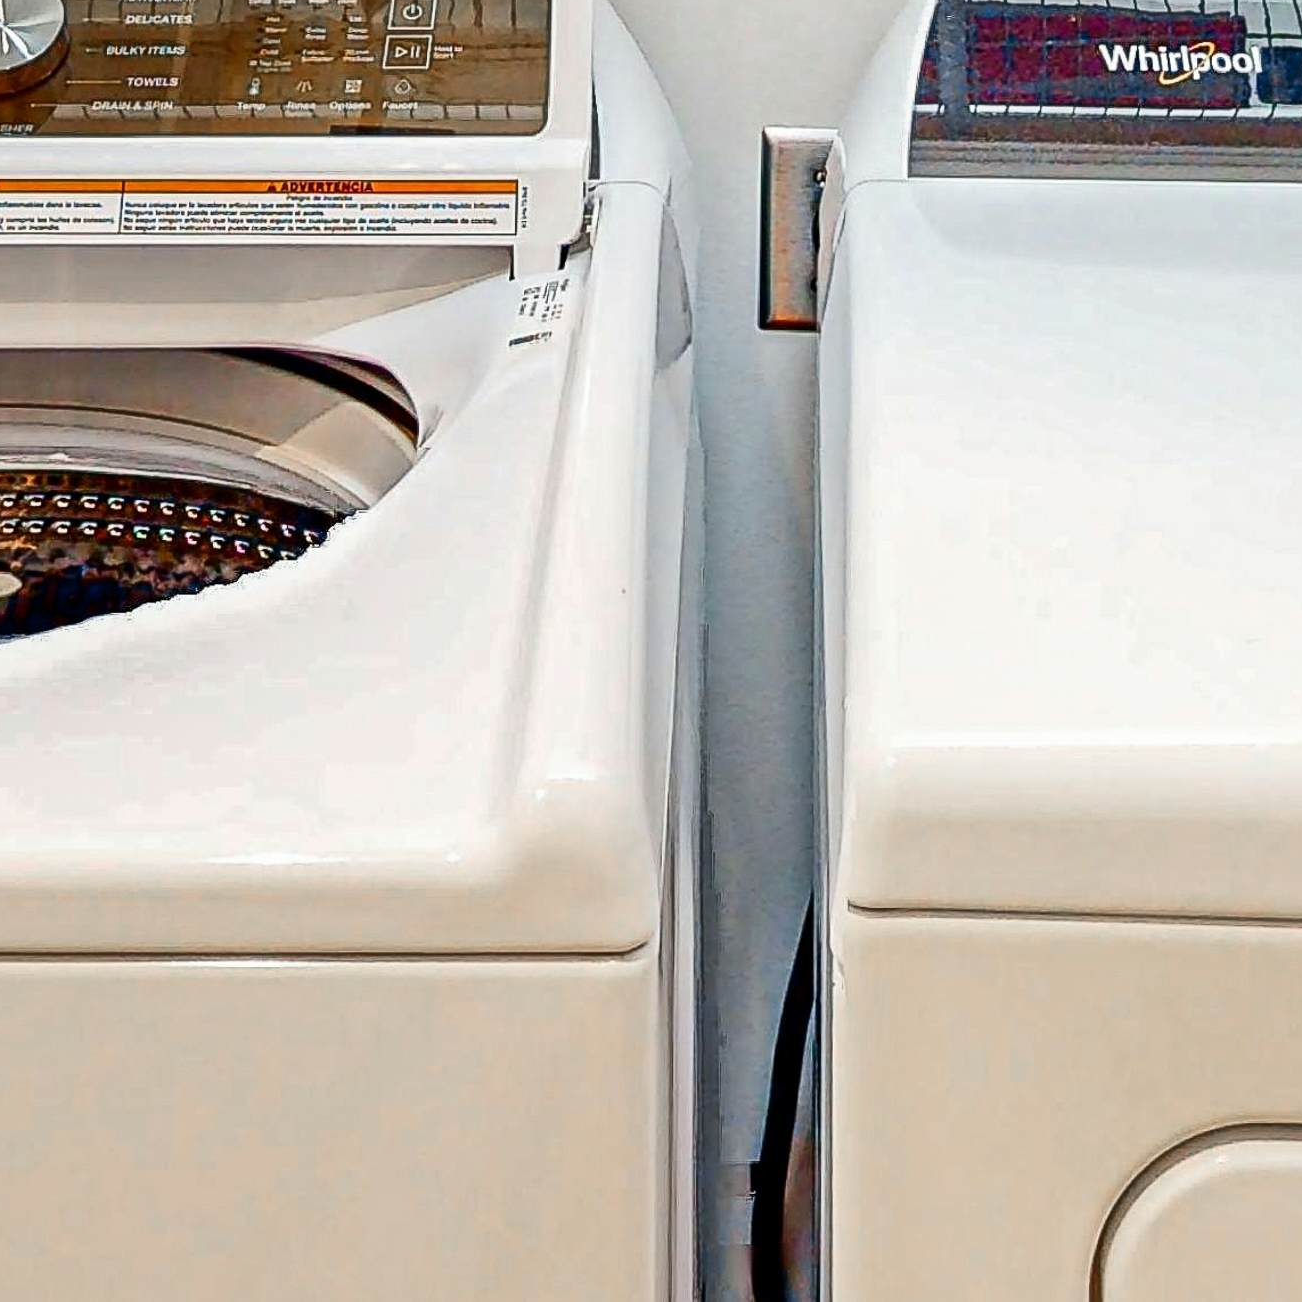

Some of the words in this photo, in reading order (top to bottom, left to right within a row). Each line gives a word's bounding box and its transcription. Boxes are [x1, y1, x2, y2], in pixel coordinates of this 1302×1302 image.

[124, 14, 193, 25] DELICATES
[106, 46, 146, 56] BULKY
[148, 46, 186, 55] ITEMS
[1100, 43, 1262, 83] Whirlpool
[126, 77, 178, 87] TOWELS
[92, 100, 131, 111] DRAIN
[237, 101, 266, 111] Temp
[329, 101, 372, 111] Options
[280, 181, 374, 193] ADVERTENCIA
